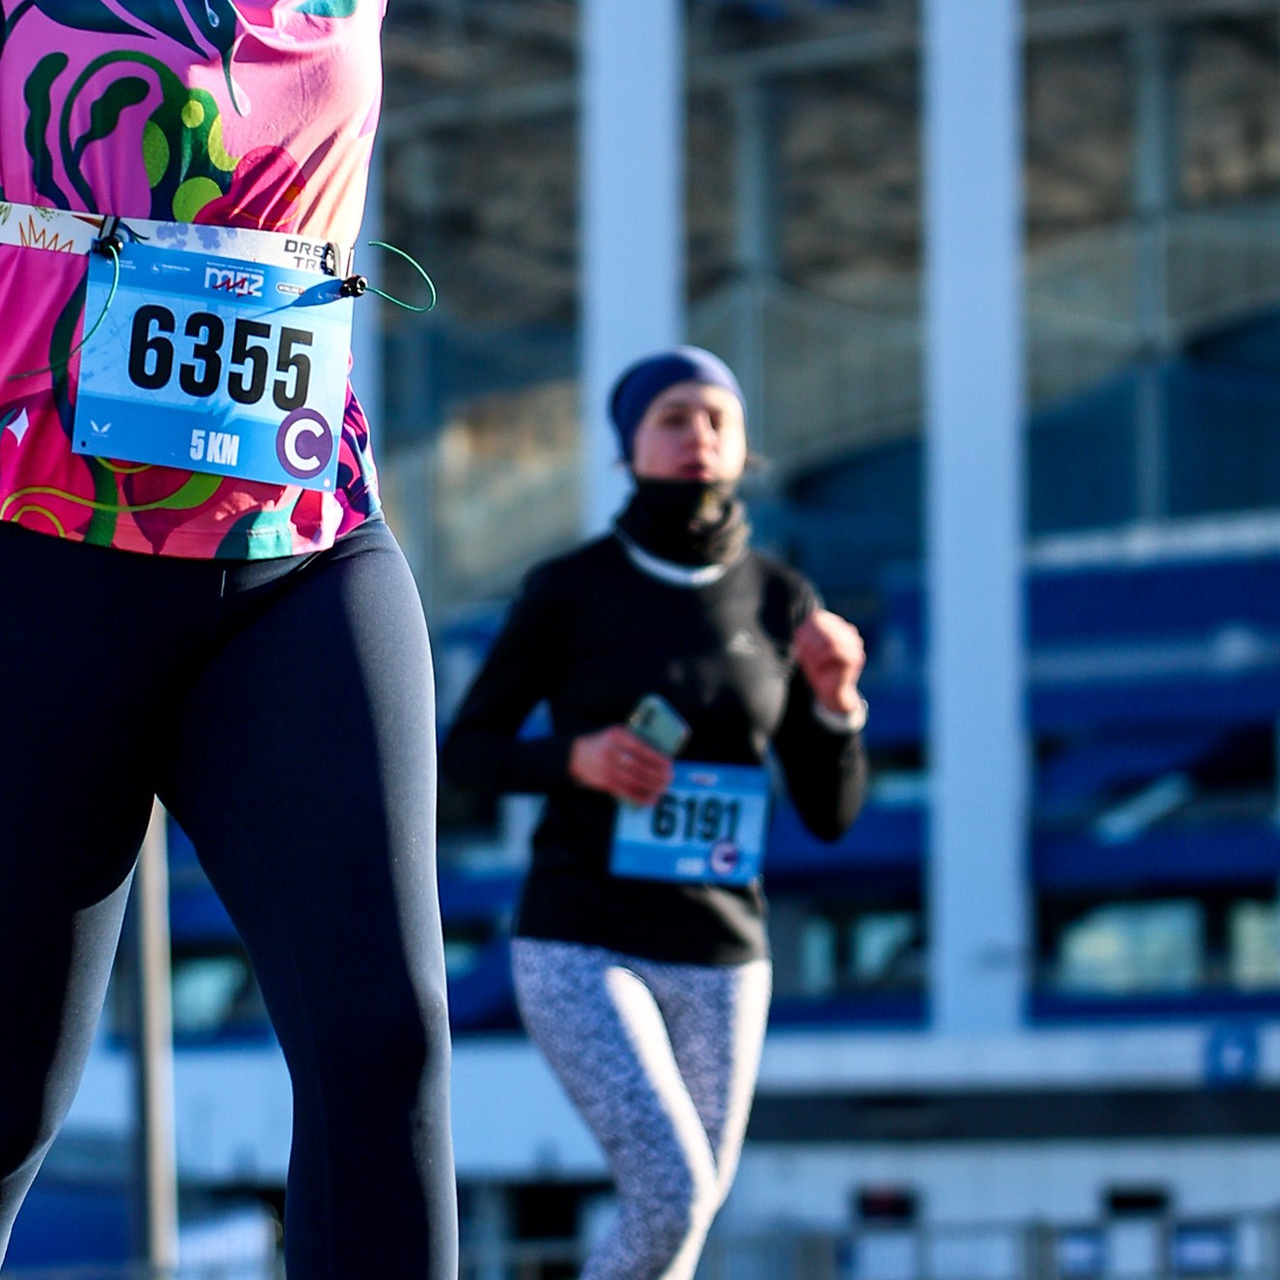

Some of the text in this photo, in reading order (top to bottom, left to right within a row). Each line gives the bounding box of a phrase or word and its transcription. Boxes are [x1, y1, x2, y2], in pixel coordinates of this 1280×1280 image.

[284, 239, 324, 258] DRE
[127, 304, 314, 411] 6355
[190, 429, 205, 461] 5
[284, 417, 325, 471] C
[651, 792, 740, 843] 6191
